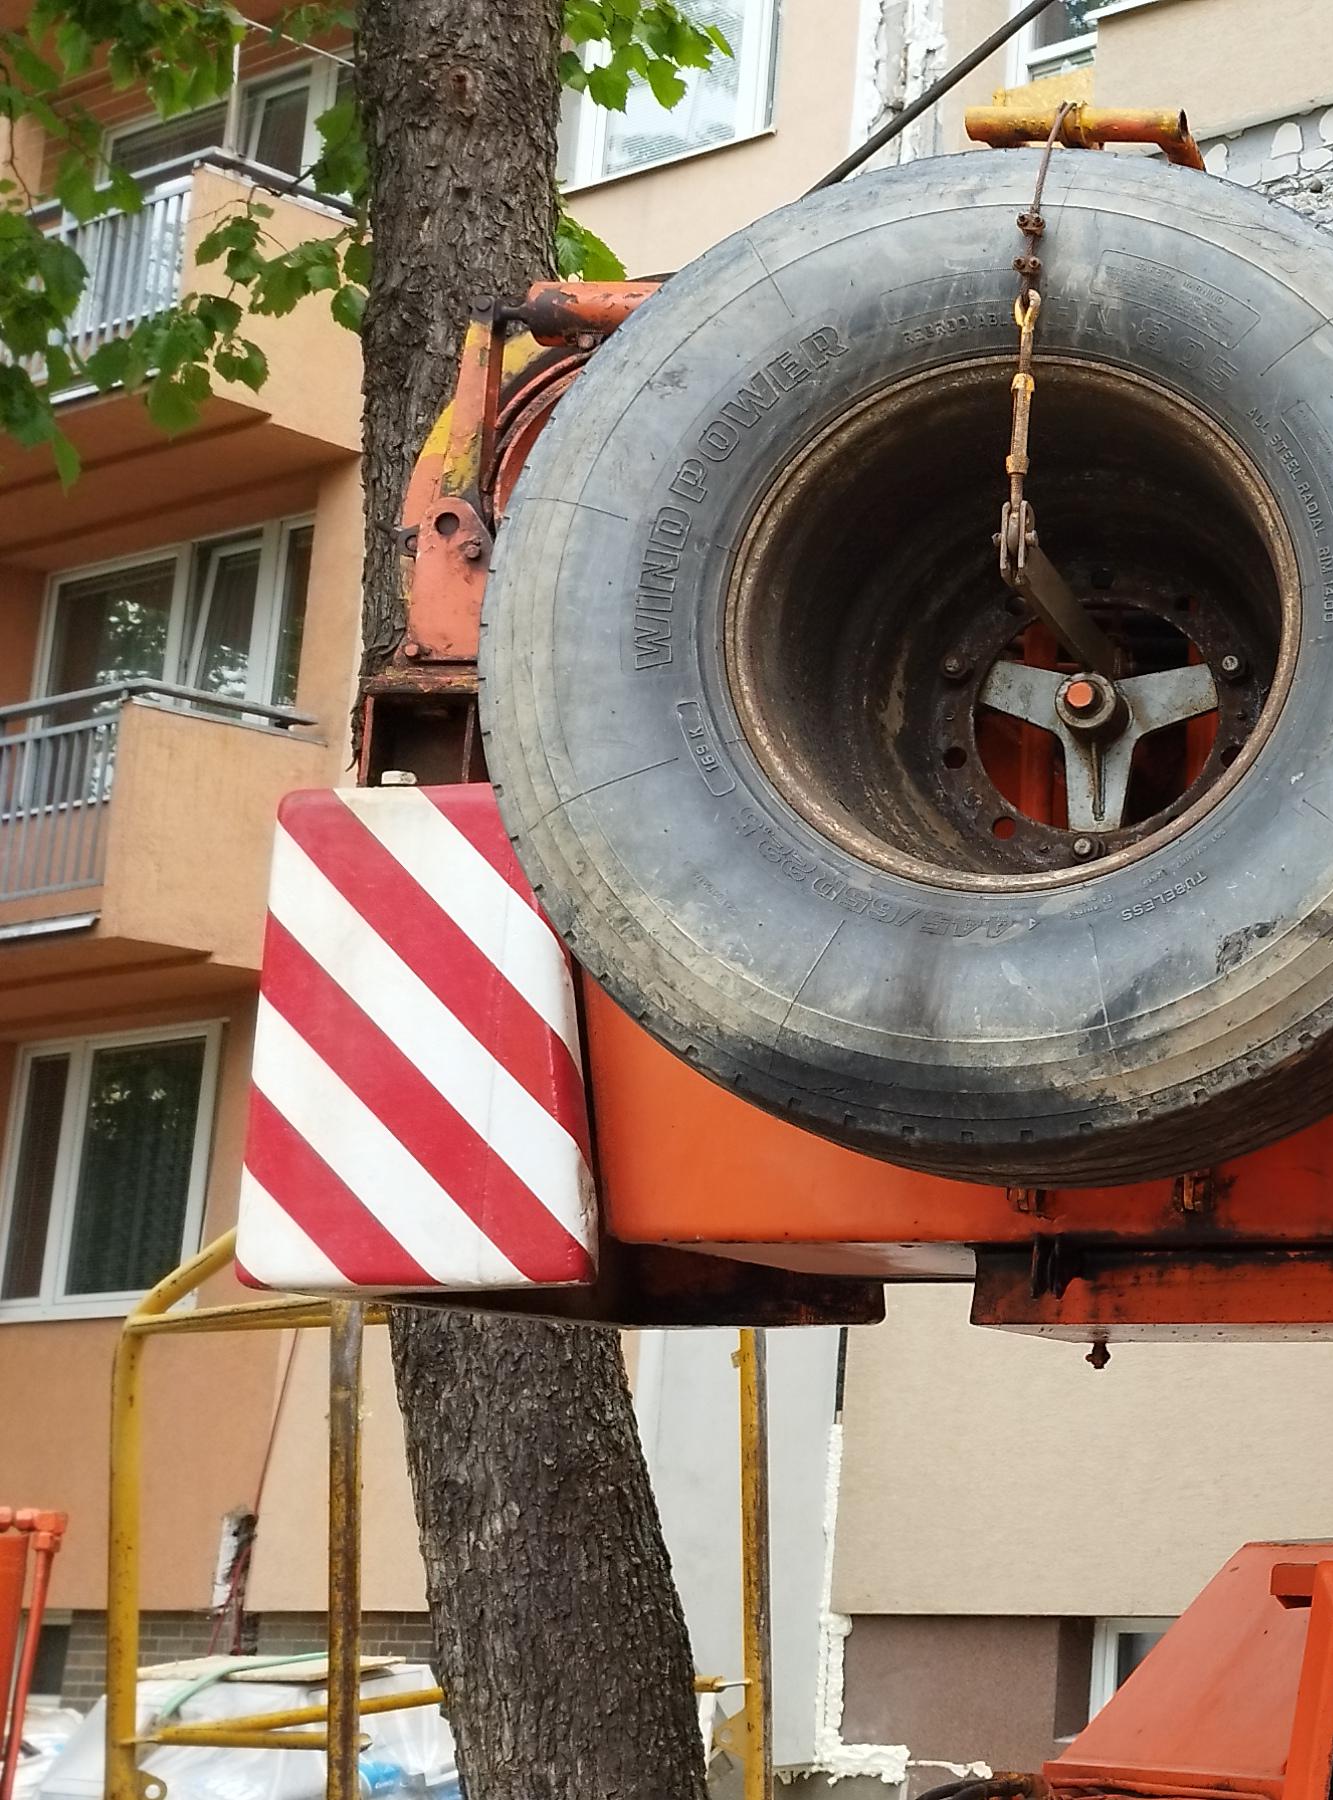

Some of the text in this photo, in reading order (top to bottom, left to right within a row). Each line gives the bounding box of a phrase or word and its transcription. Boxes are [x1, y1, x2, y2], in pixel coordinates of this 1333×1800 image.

[1245, 406, 1270, 433] ALL
[1268, 433, 1302, 480] STEEL
[1297, 480, 1325, 537] RADIAL
[1317, 544, 1333, 573] RIM
[689, 725, 719, 773] 169 K
[1120, 870, 1208, 921] TUBELESS
